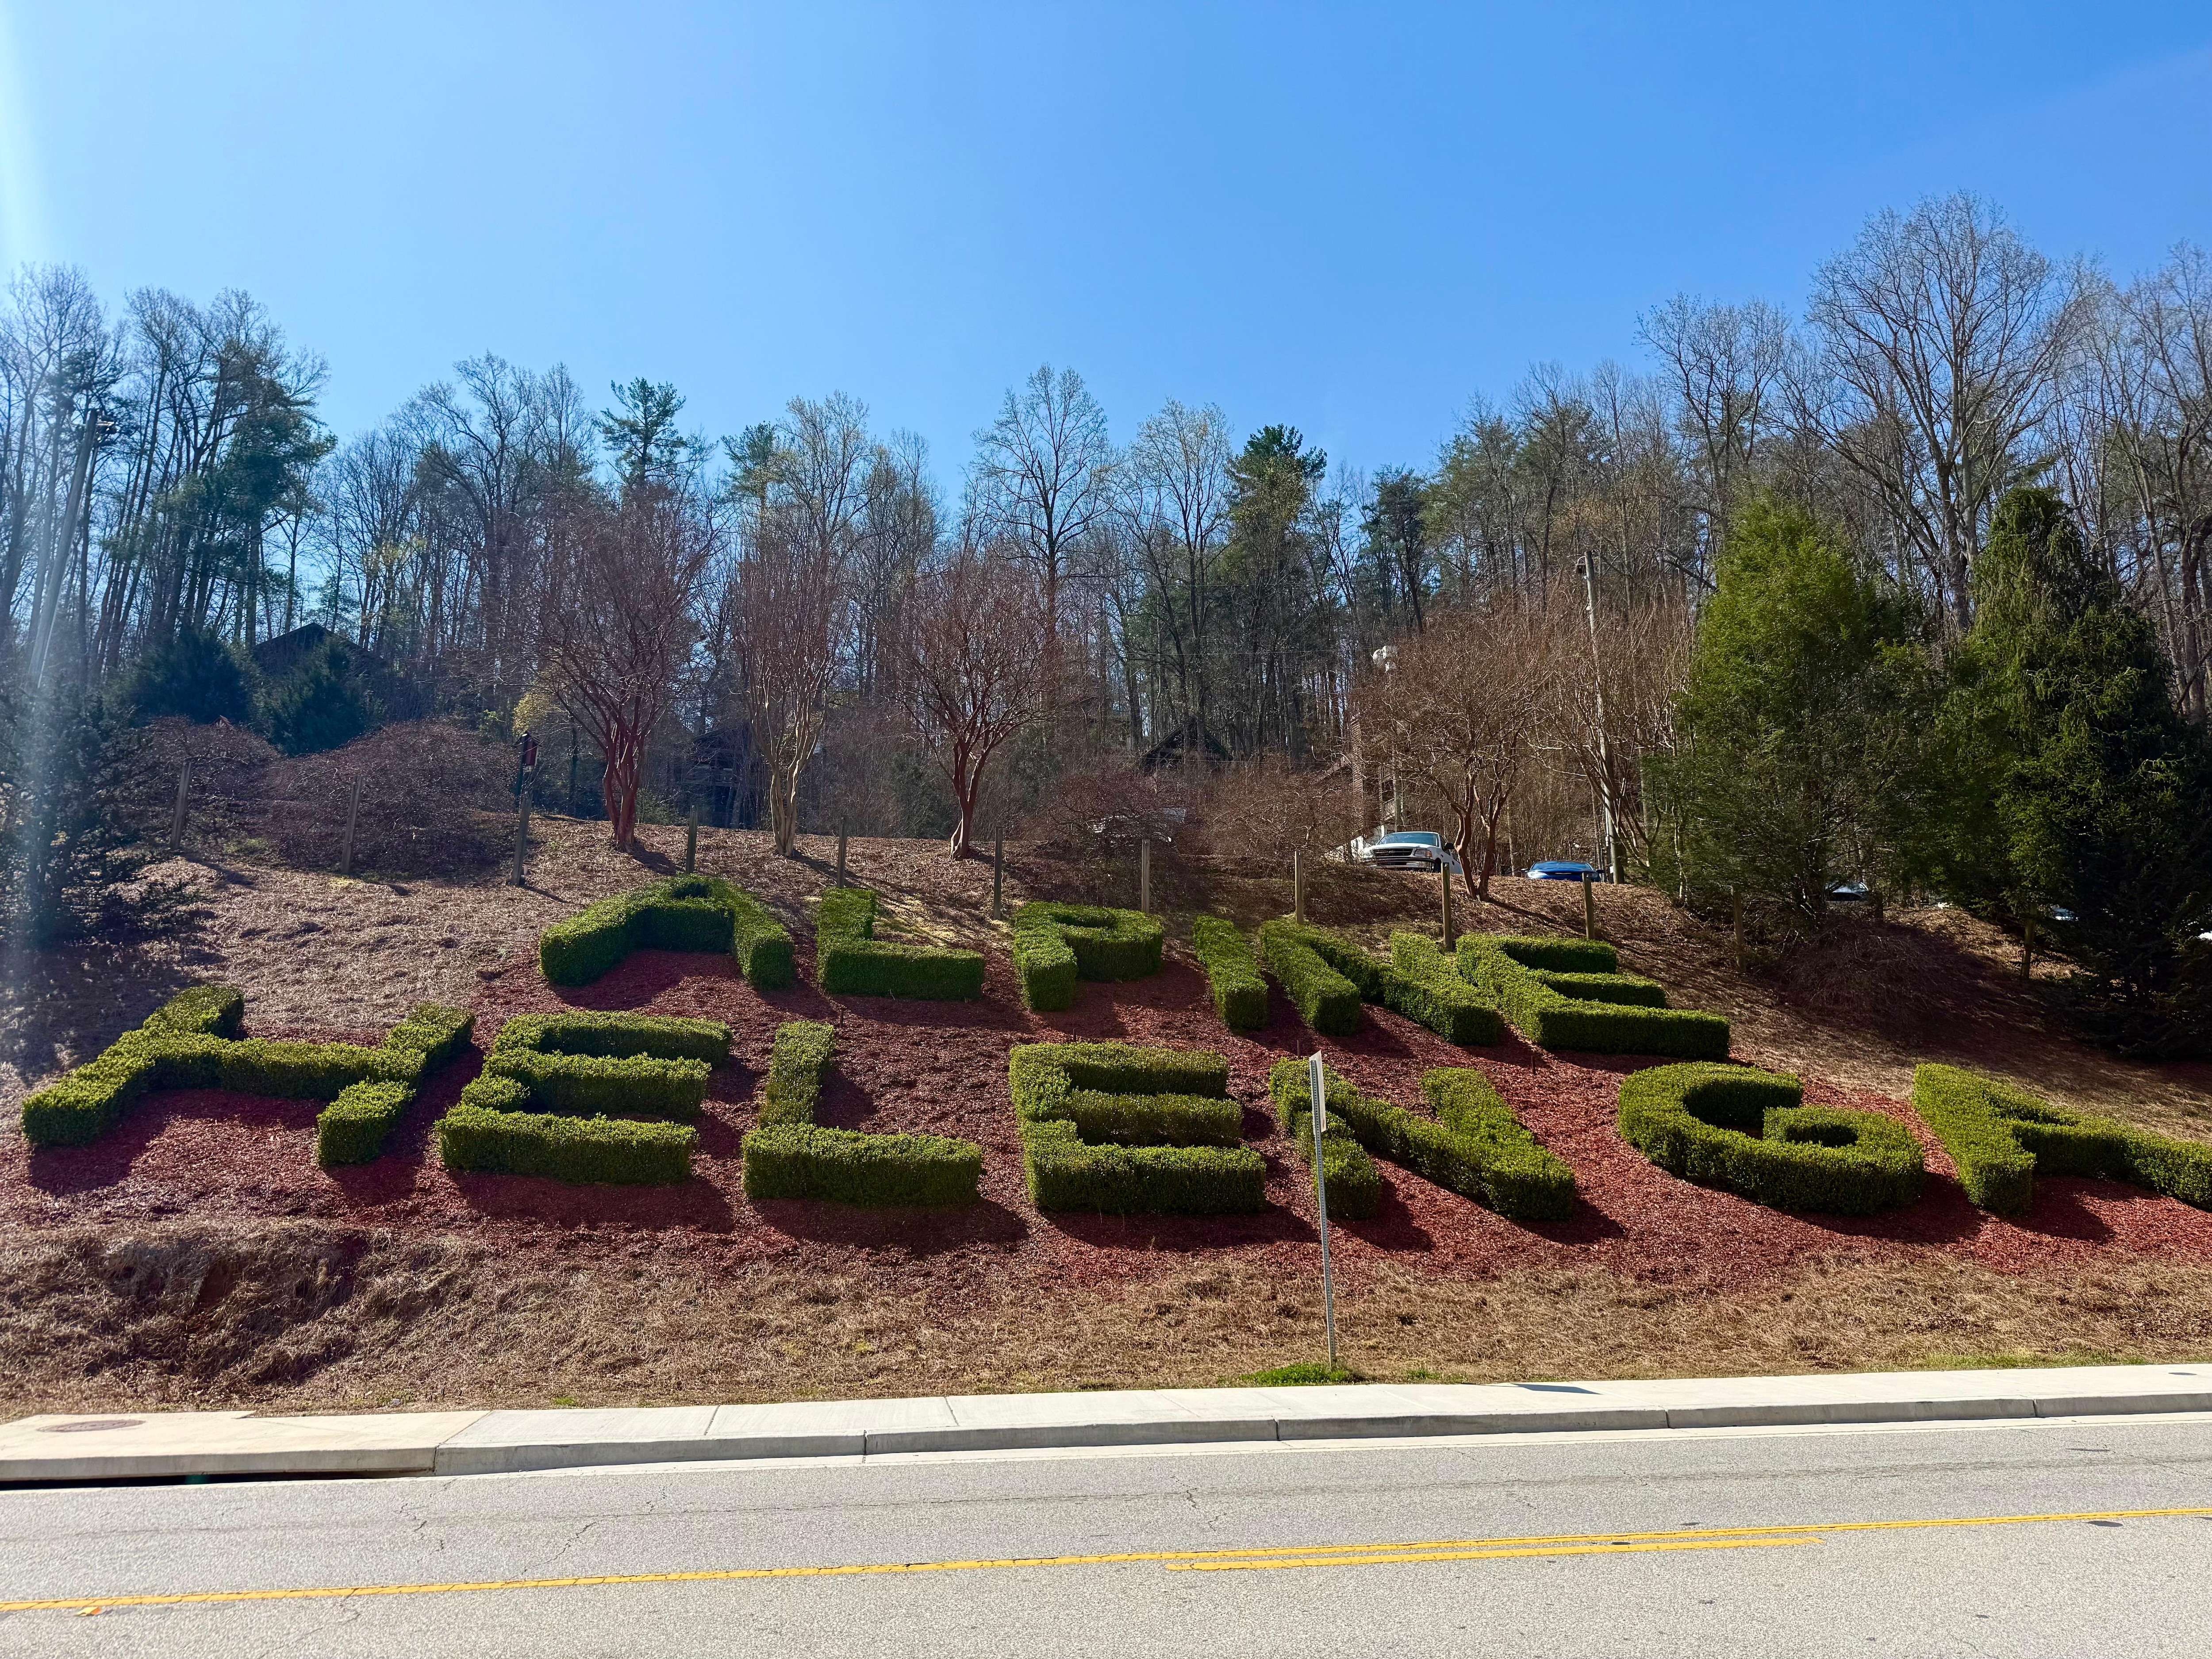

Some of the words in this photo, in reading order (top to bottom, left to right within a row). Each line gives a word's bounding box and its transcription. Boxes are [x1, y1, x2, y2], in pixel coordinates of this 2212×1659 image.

[541, 875, 1729, 1056] ALPINE
[23, 984, 1576, 1220] HELEN
[1619, 1062, 2212, 1216] GA
